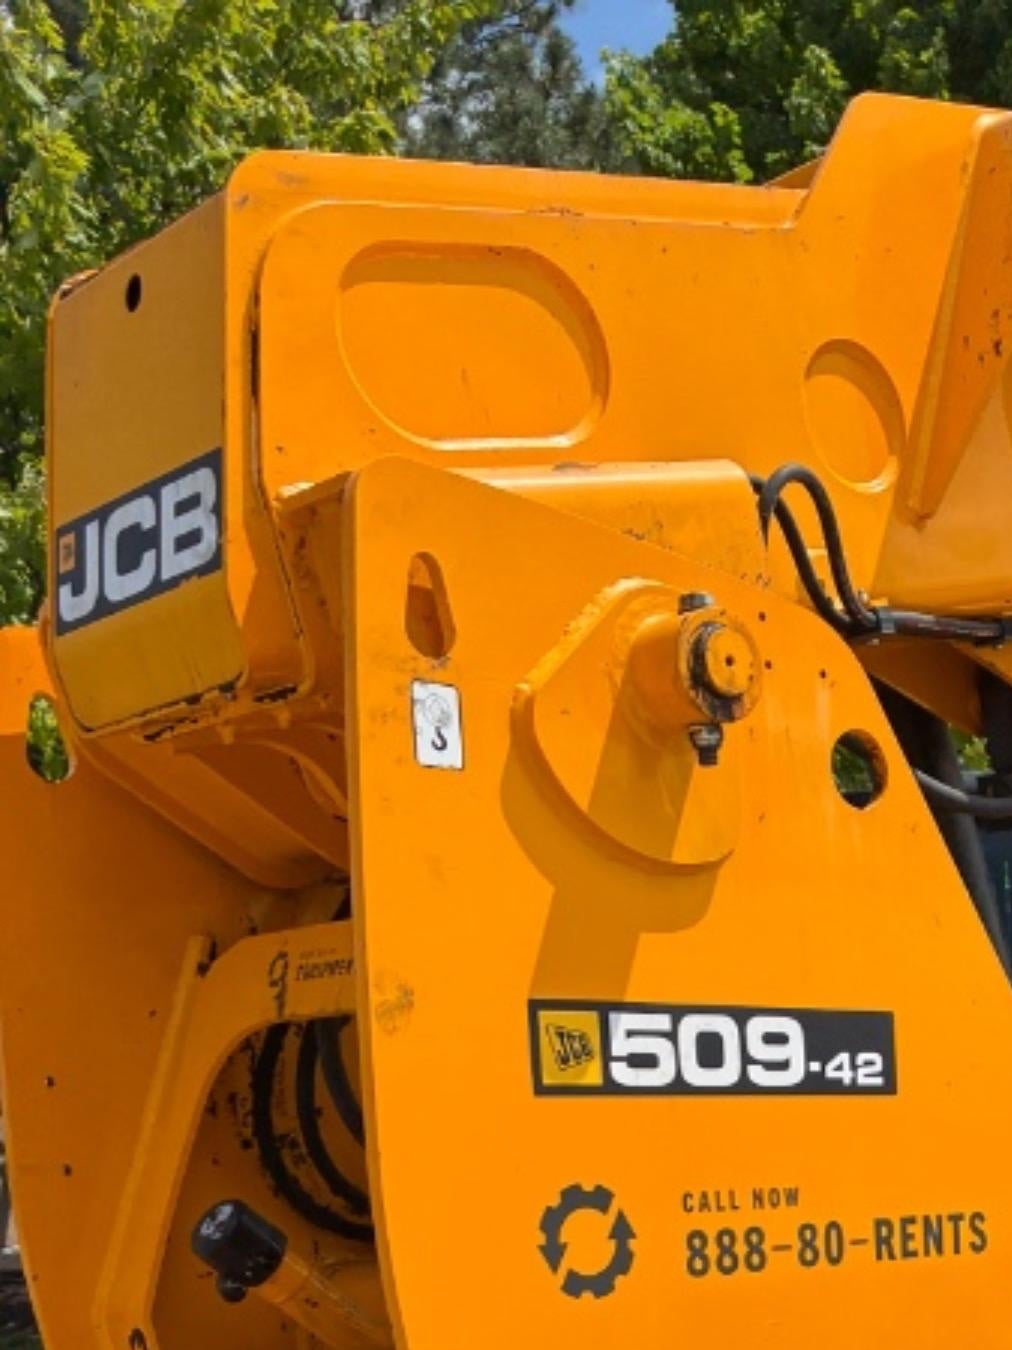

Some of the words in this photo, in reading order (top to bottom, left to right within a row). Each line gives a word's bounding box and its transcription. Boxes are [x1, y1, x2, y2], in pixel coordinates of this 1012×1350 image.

[58, 466, 218, 622] JCB
[549, 1026, 594, 1070] JCB
[607, 1012, 885, 1087] 509-42
[682, 1191, 740, 1214] CALL
[752, 1187, 801, 1208] NOW
[686, 1212, 988, 1278] 888-80-RENTS
